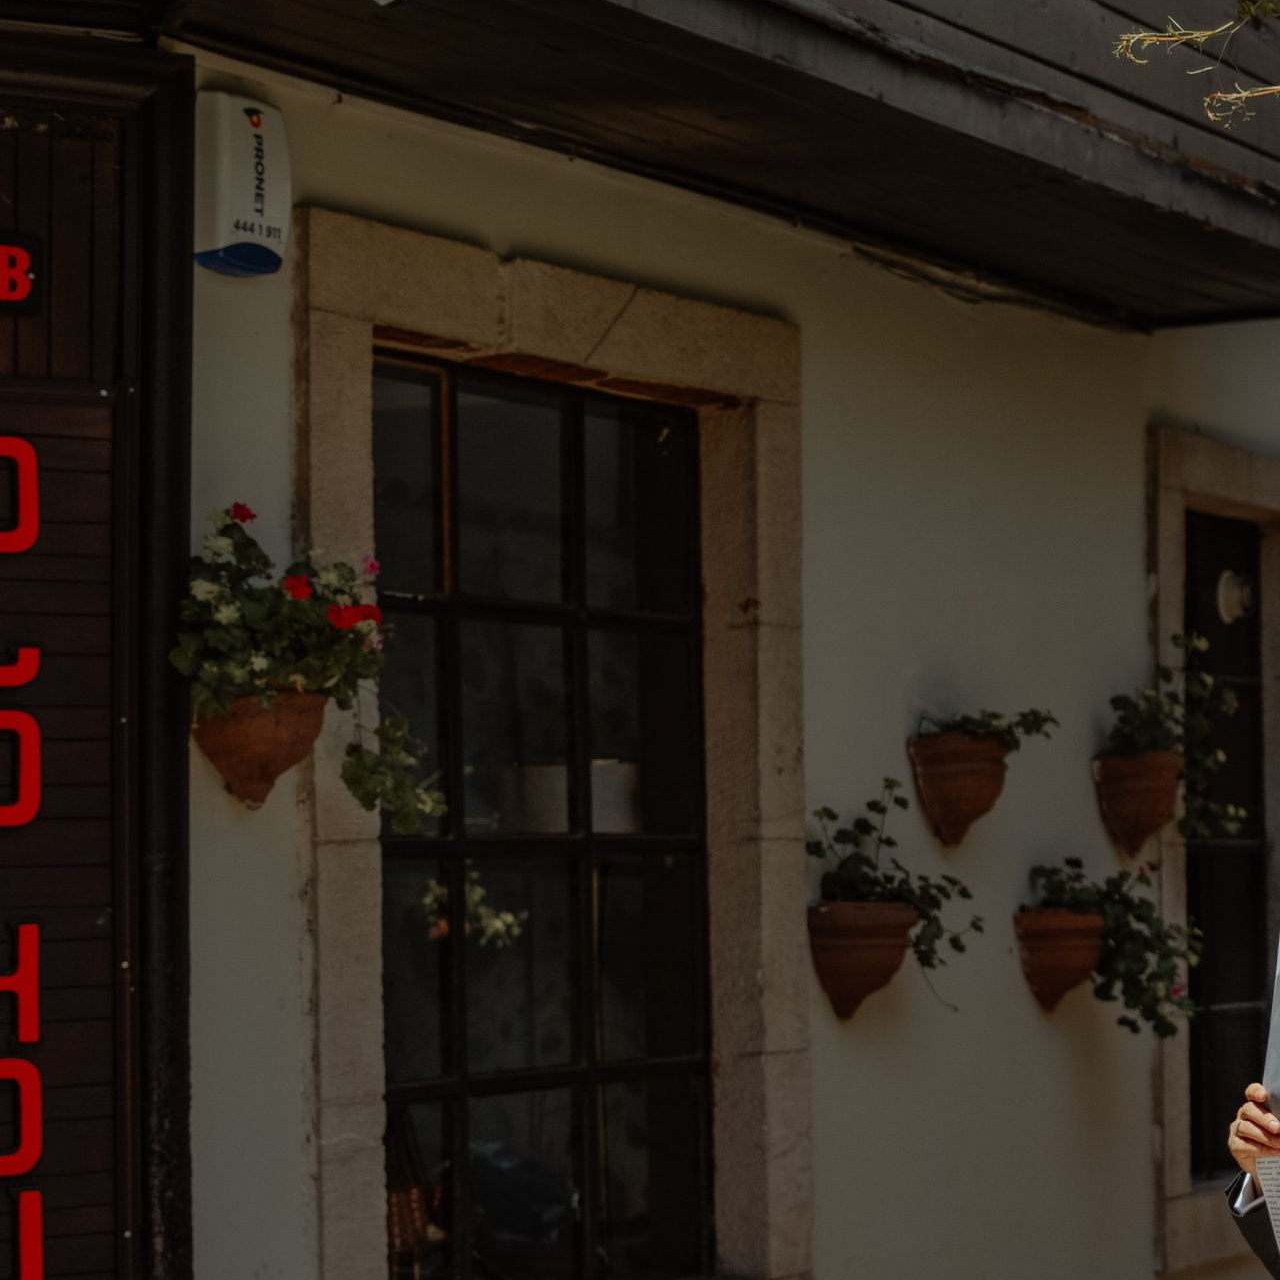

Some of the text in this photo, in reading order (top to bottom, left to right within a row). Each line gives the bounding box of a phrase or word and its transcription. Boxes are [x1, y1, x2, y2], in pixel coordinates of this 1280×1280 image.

[252, 133, 265, 217] PRONET
[233, 219, 255, 234] 444
[265, 225, 282, 241] 911
